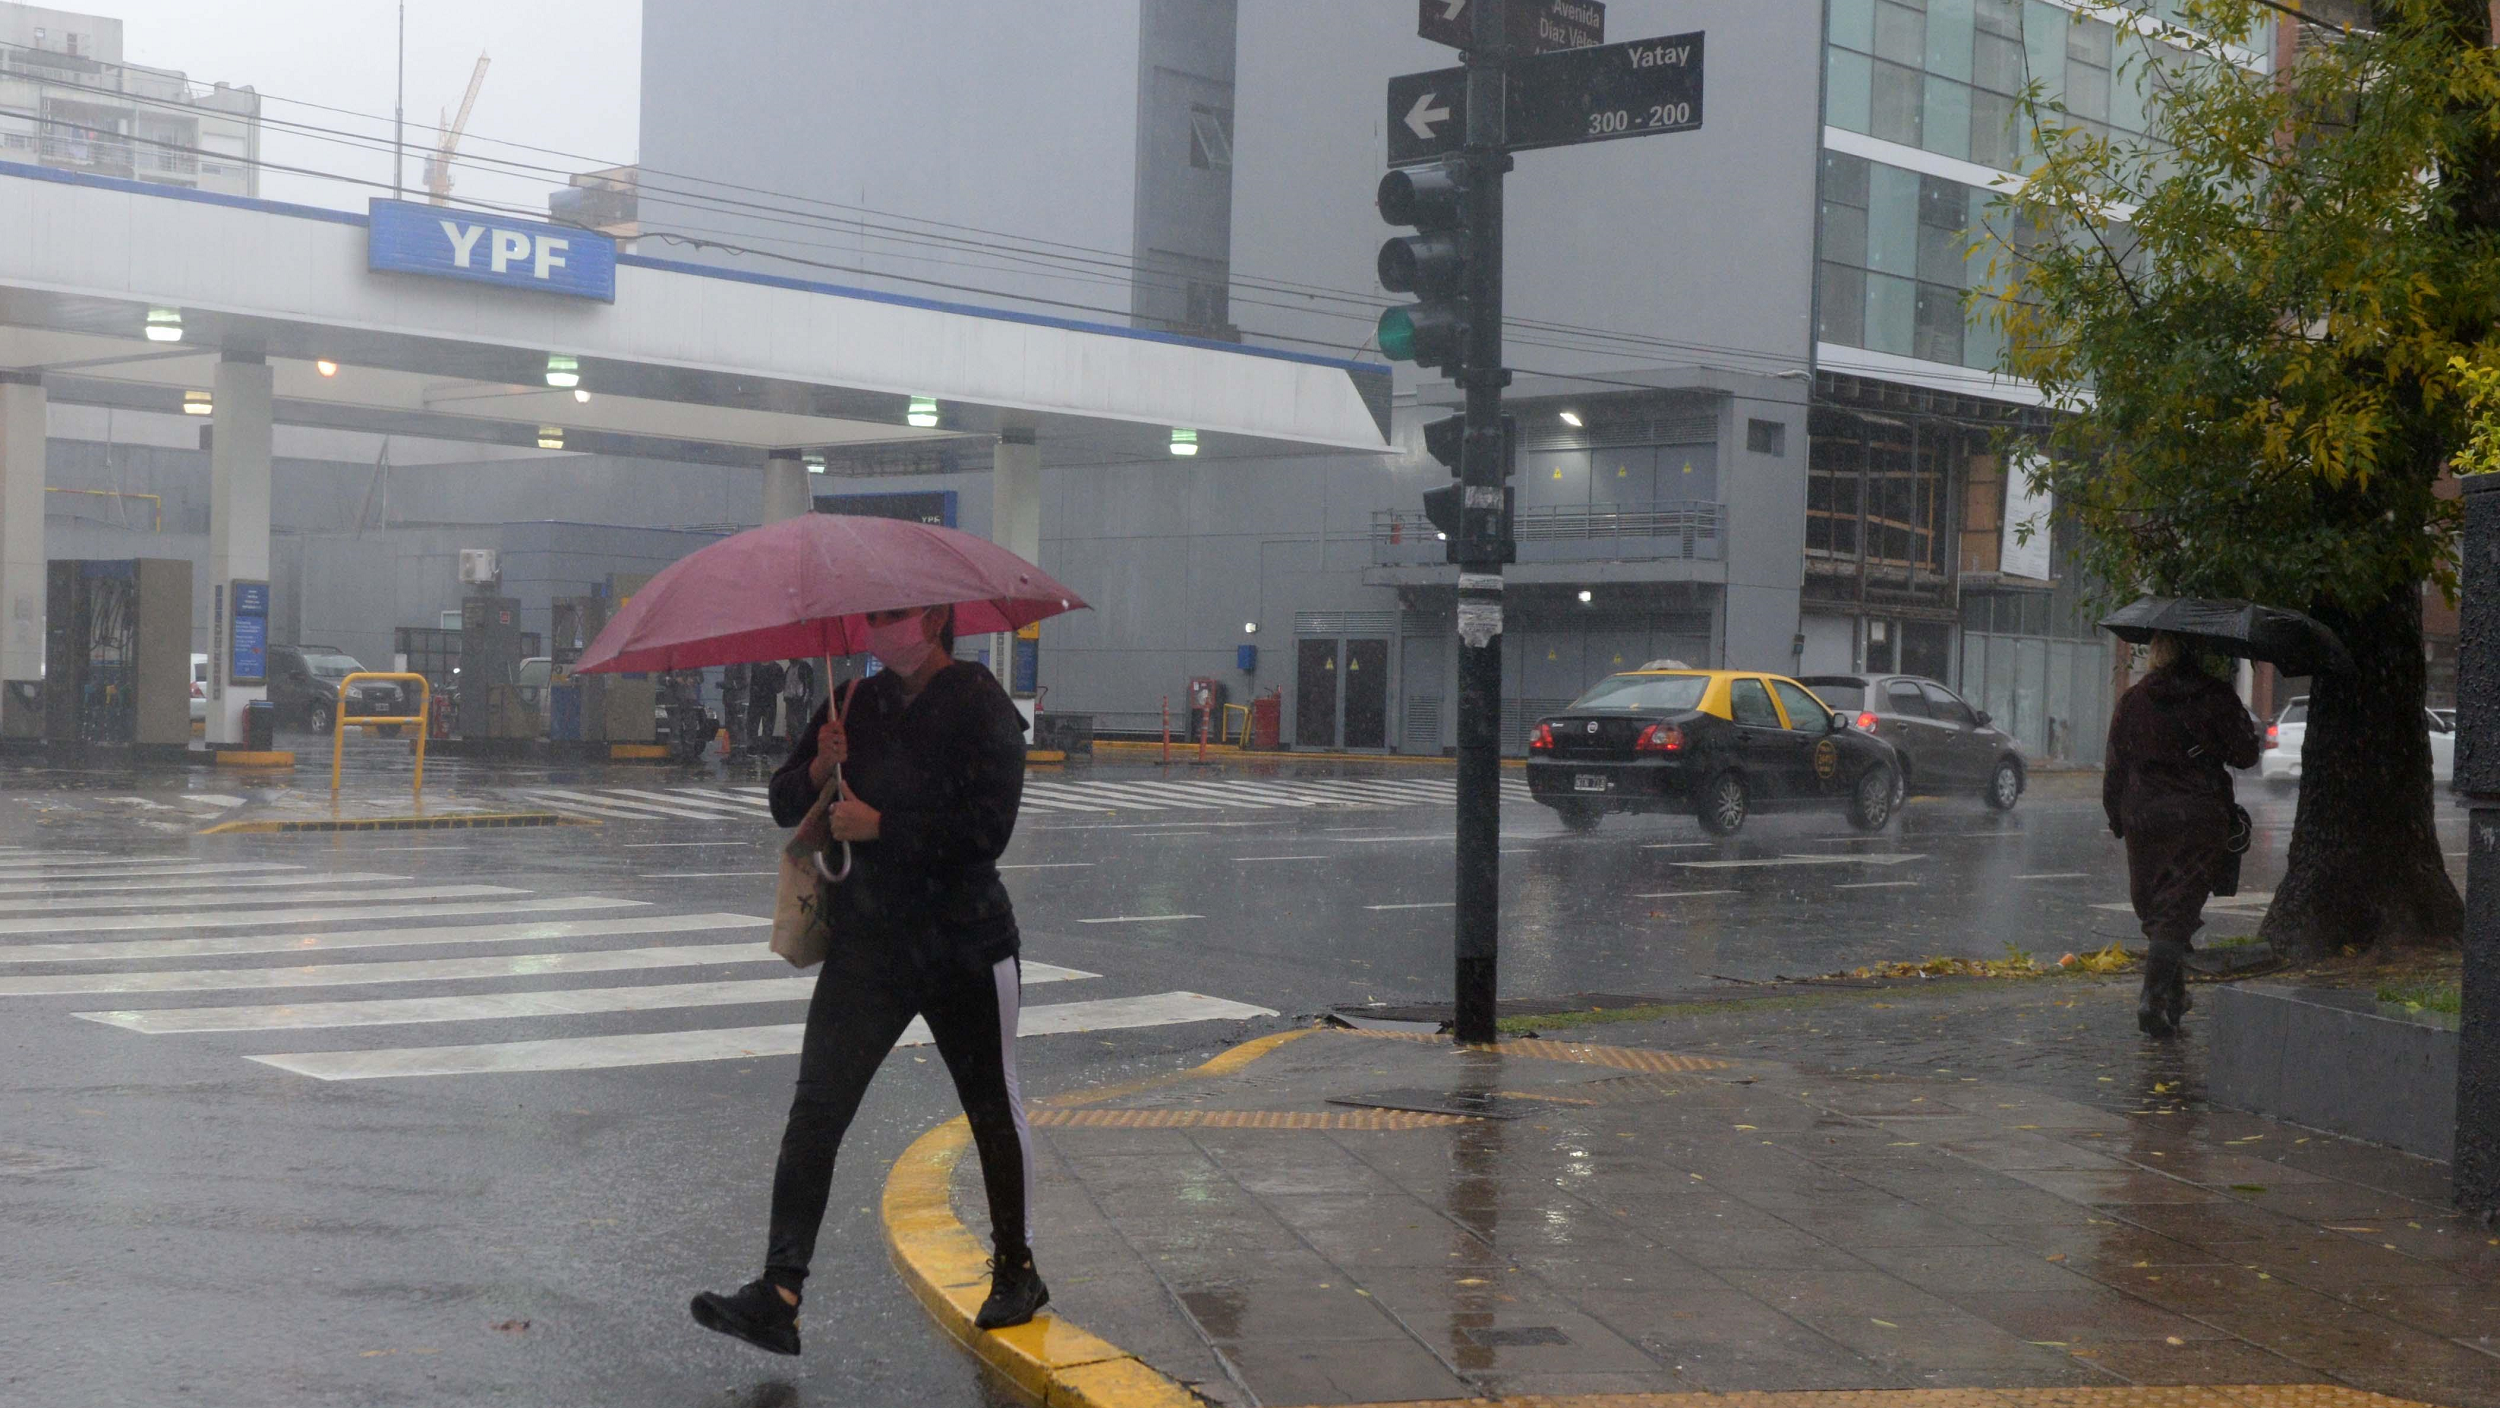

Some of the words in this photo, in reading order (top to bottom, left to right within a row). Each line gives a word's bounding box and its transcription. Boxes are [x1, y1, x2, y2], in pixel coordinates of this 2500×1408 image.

[1554, 0, 1600, 28] Avenida
[1540, 17, 1565, 44] Díaz
[1628, 45, 1690, 69] Yatay
[1588, 110, 1628, 134] 300
[1649, 102, 1690, 127] 200
[439, 220, 569, 280] YPF
[921, 515, 941, 523] YPF
